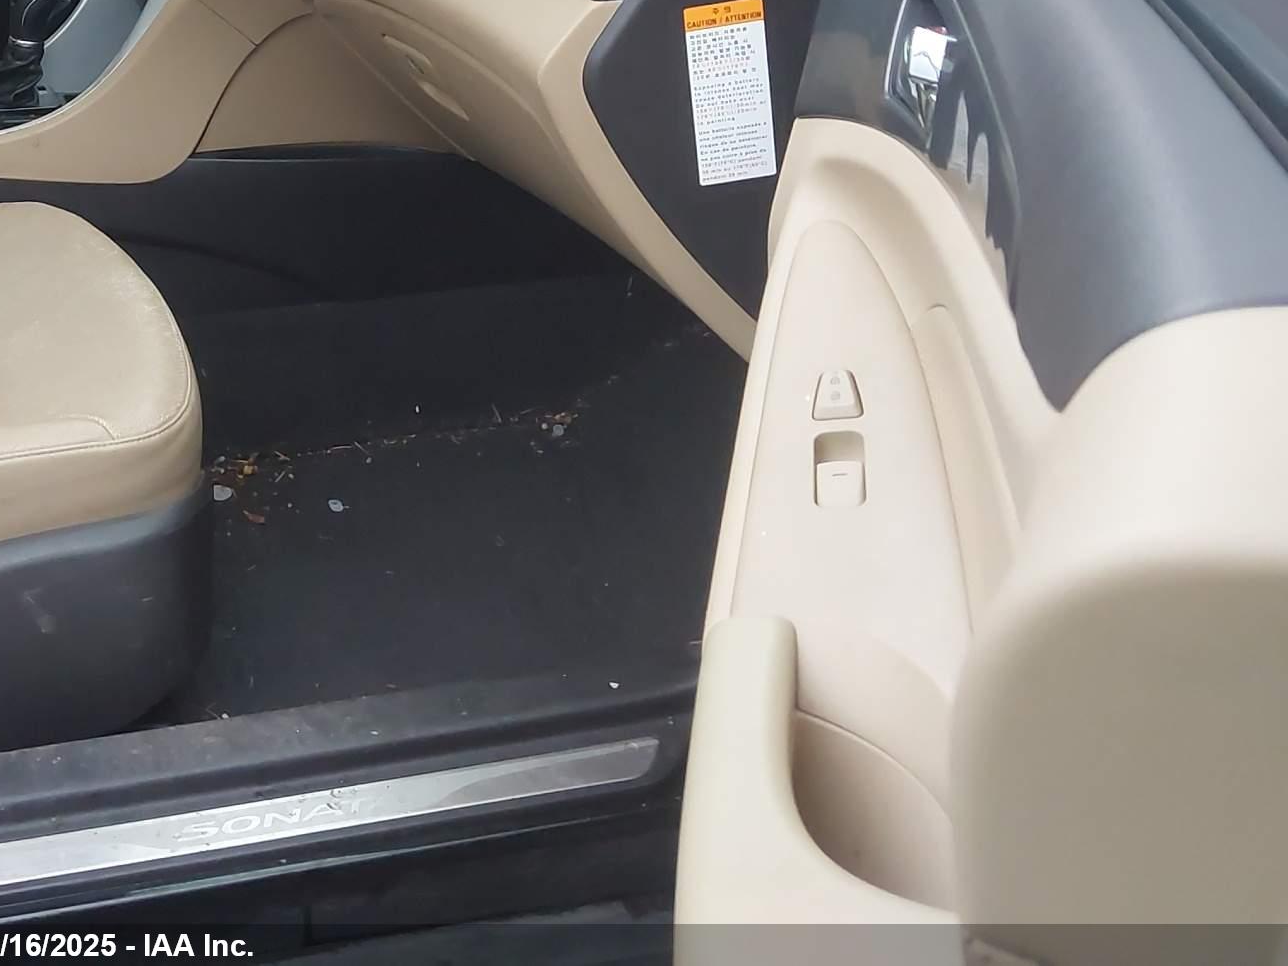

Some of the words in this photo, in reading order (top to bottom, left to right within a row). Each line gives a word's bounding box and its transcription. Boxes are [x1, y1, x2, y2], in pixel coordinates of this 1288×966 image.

[687, 18, 716, 29] CAUTION
[726, 12, 761, 22] ATTENTION
[177, 795, 372, 842] SONAT
